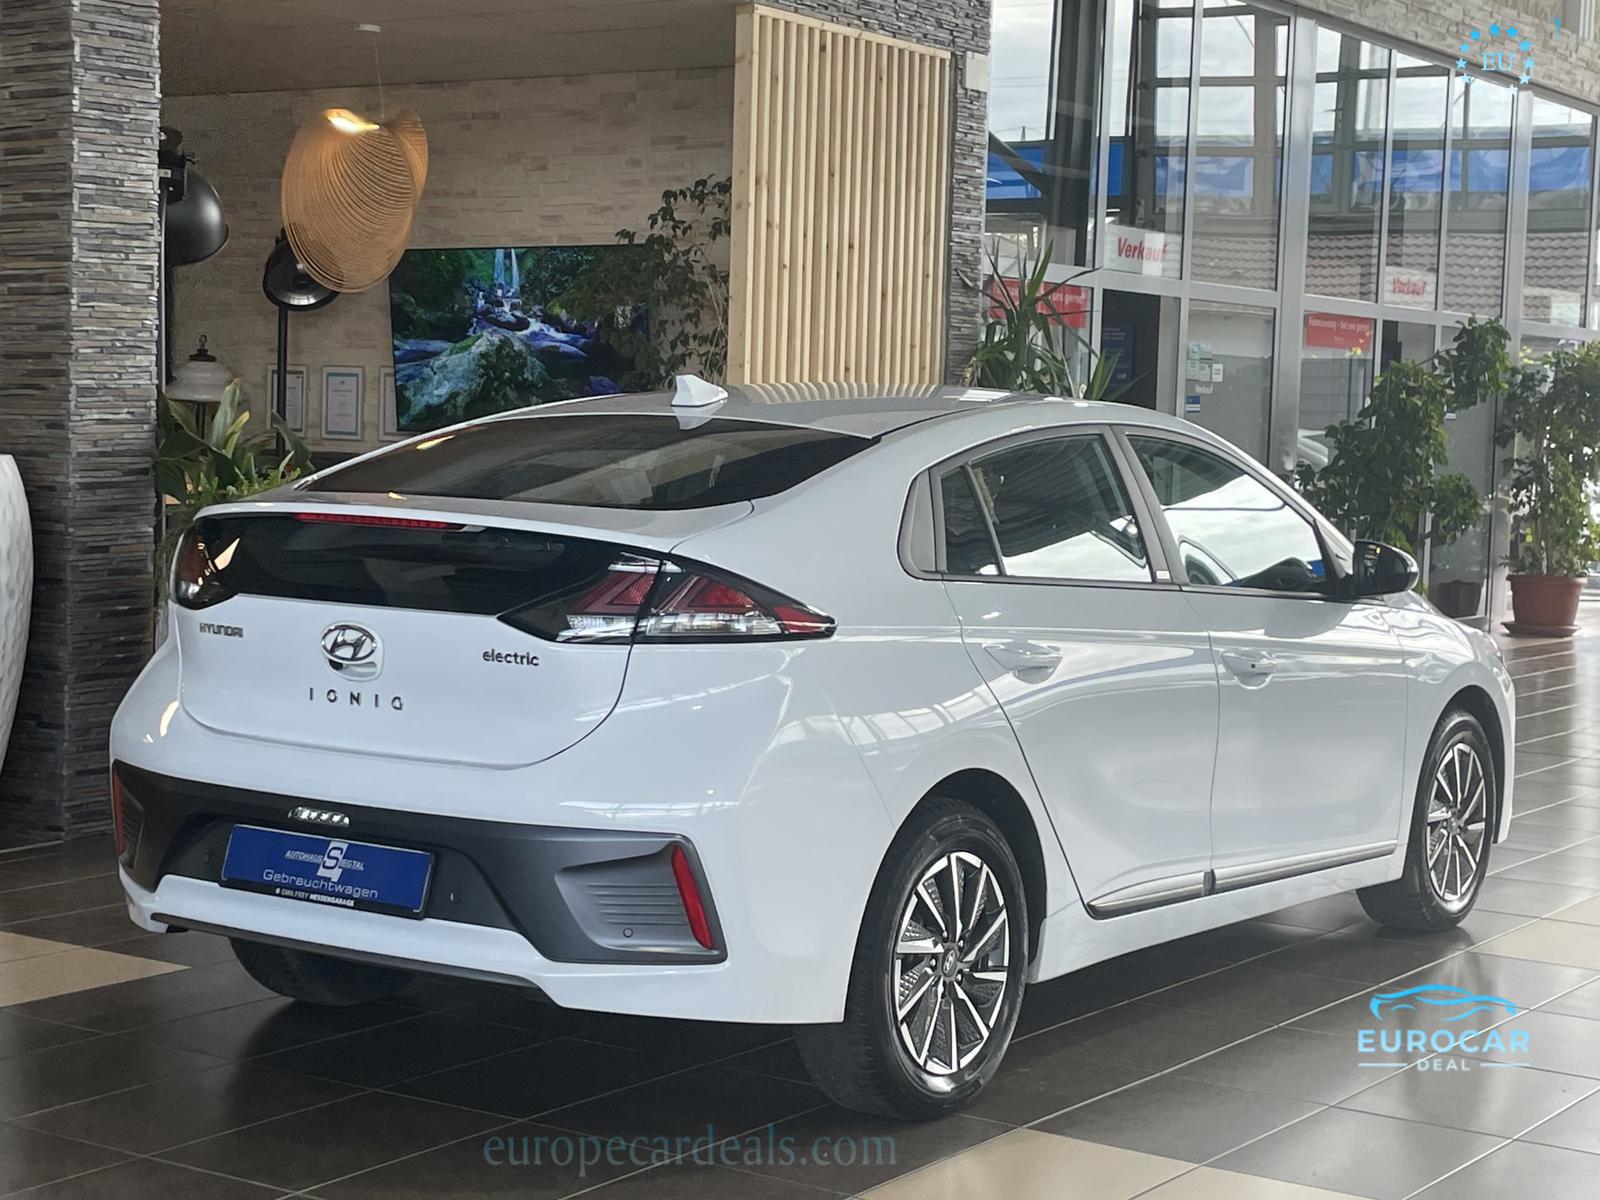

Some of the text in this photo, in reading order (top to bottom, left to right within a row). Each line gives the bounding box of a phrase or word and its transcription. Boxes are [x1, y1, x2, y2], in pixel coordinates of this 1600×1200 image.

[1117, 236, 1168, 262] Verkauf
[1392, 276, 1425, 297] Verkauf
[200, 622, 244, 638] HYUNDAI
[482, 648, 540, 666] electric
[309, 687, 404, 711] IONIQ
[284, 849, 324, 865] AUTOHAUS
[263, 869, 378, 899] Gebrauchtwagen
